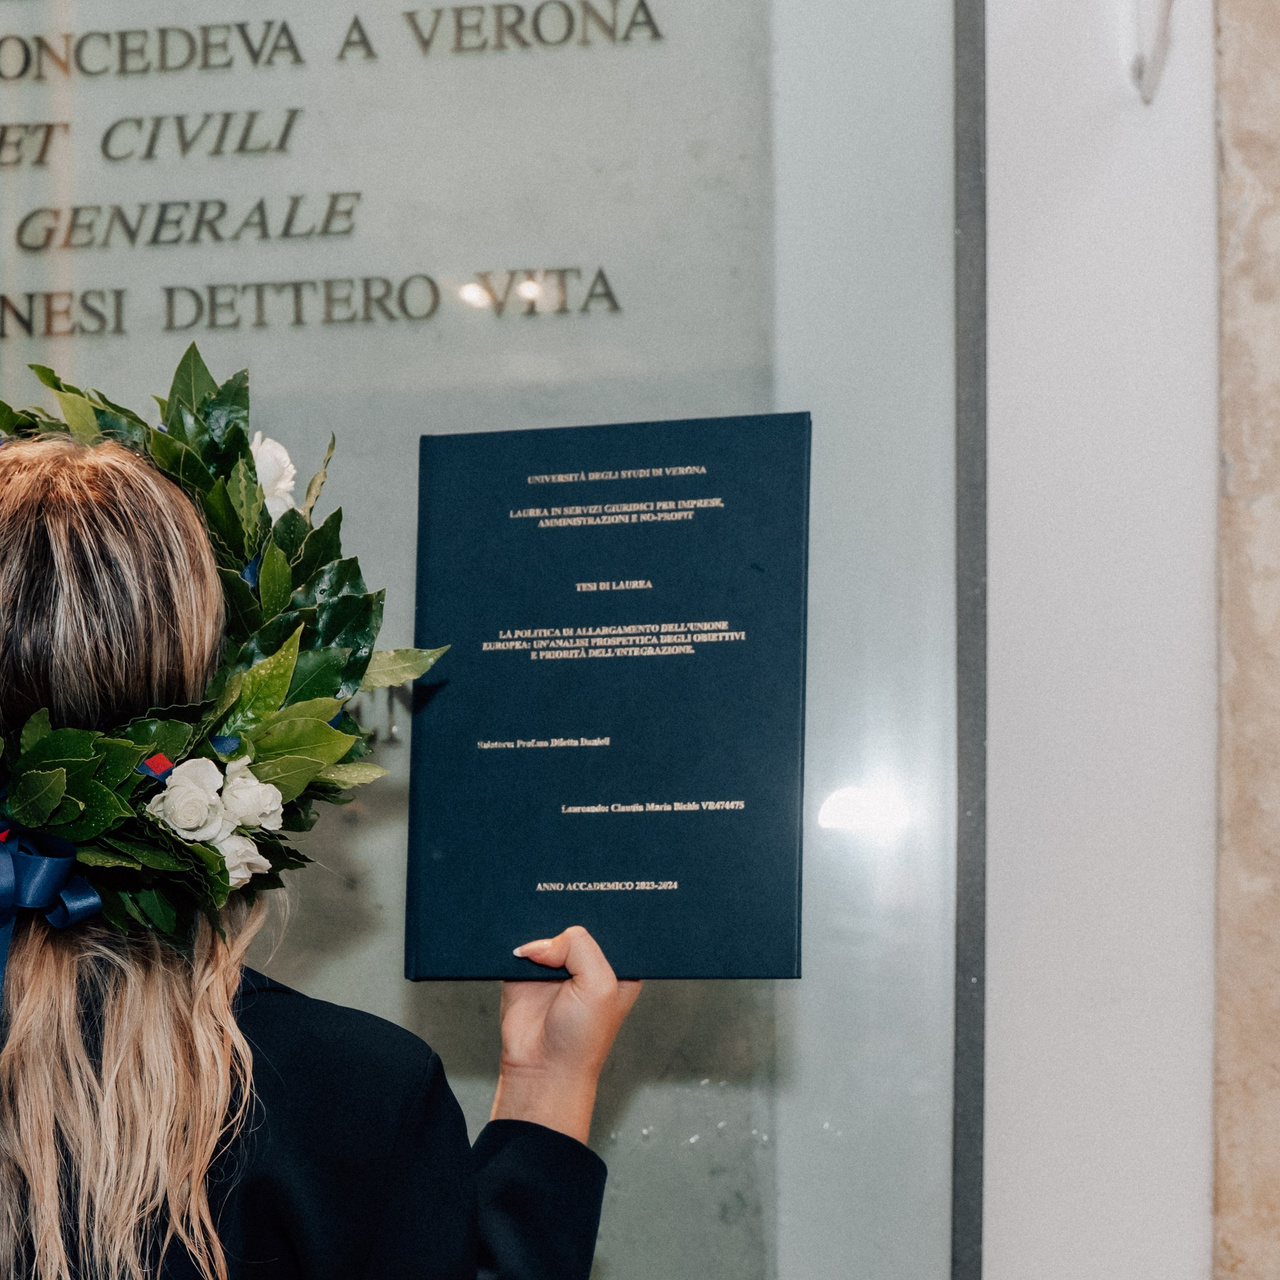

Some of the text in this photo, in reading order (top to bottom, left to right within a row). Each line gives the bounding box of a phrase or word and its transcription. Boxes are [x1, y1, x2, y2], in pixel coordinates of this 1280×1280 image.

[337, 15, 379, 62] A
[402, 0, 664, 55] VERONA
[100, 108, 304, 162] CIVILI
[15, 191, 363, 252] GENERALE
[162, 274, 440, 332] DETTERO
[475, 267, 622, 316] VITA
[527, 465, 707, 484] UNIVERSITÀ DEGLI STUDI DI VERONA
[509, 507, 549, 518] LAUREA
[551, 507, 562, 516] IN
[563, 504, 602, 515] SERVIZI
[603, 502, 654, 513] GIURIDICI
[656, 501, 676, 510] PER
[631, 514, 638, 523] E
[576, 580, 653, 592] TESI DI LAUREA
[499, 630, 513, 639] LA
[515, 628, 561, 638] POLITICA
[563, 627, 573, 636] DI
[576, 624, 659, 635] ALLARGAMENTO
[482, 641, 531, 651] EUROPEA:
[591, 634, 658, 647] PROSPETTICA
[660, 633, 691, 644] DEGLI
[693, 632, 745, 642] OBIETTIVI
[531, 651, 537, 660] E
[536, 883, 564, 891] ANNO
[566, 881, 634, 890] ACCADEMICO
